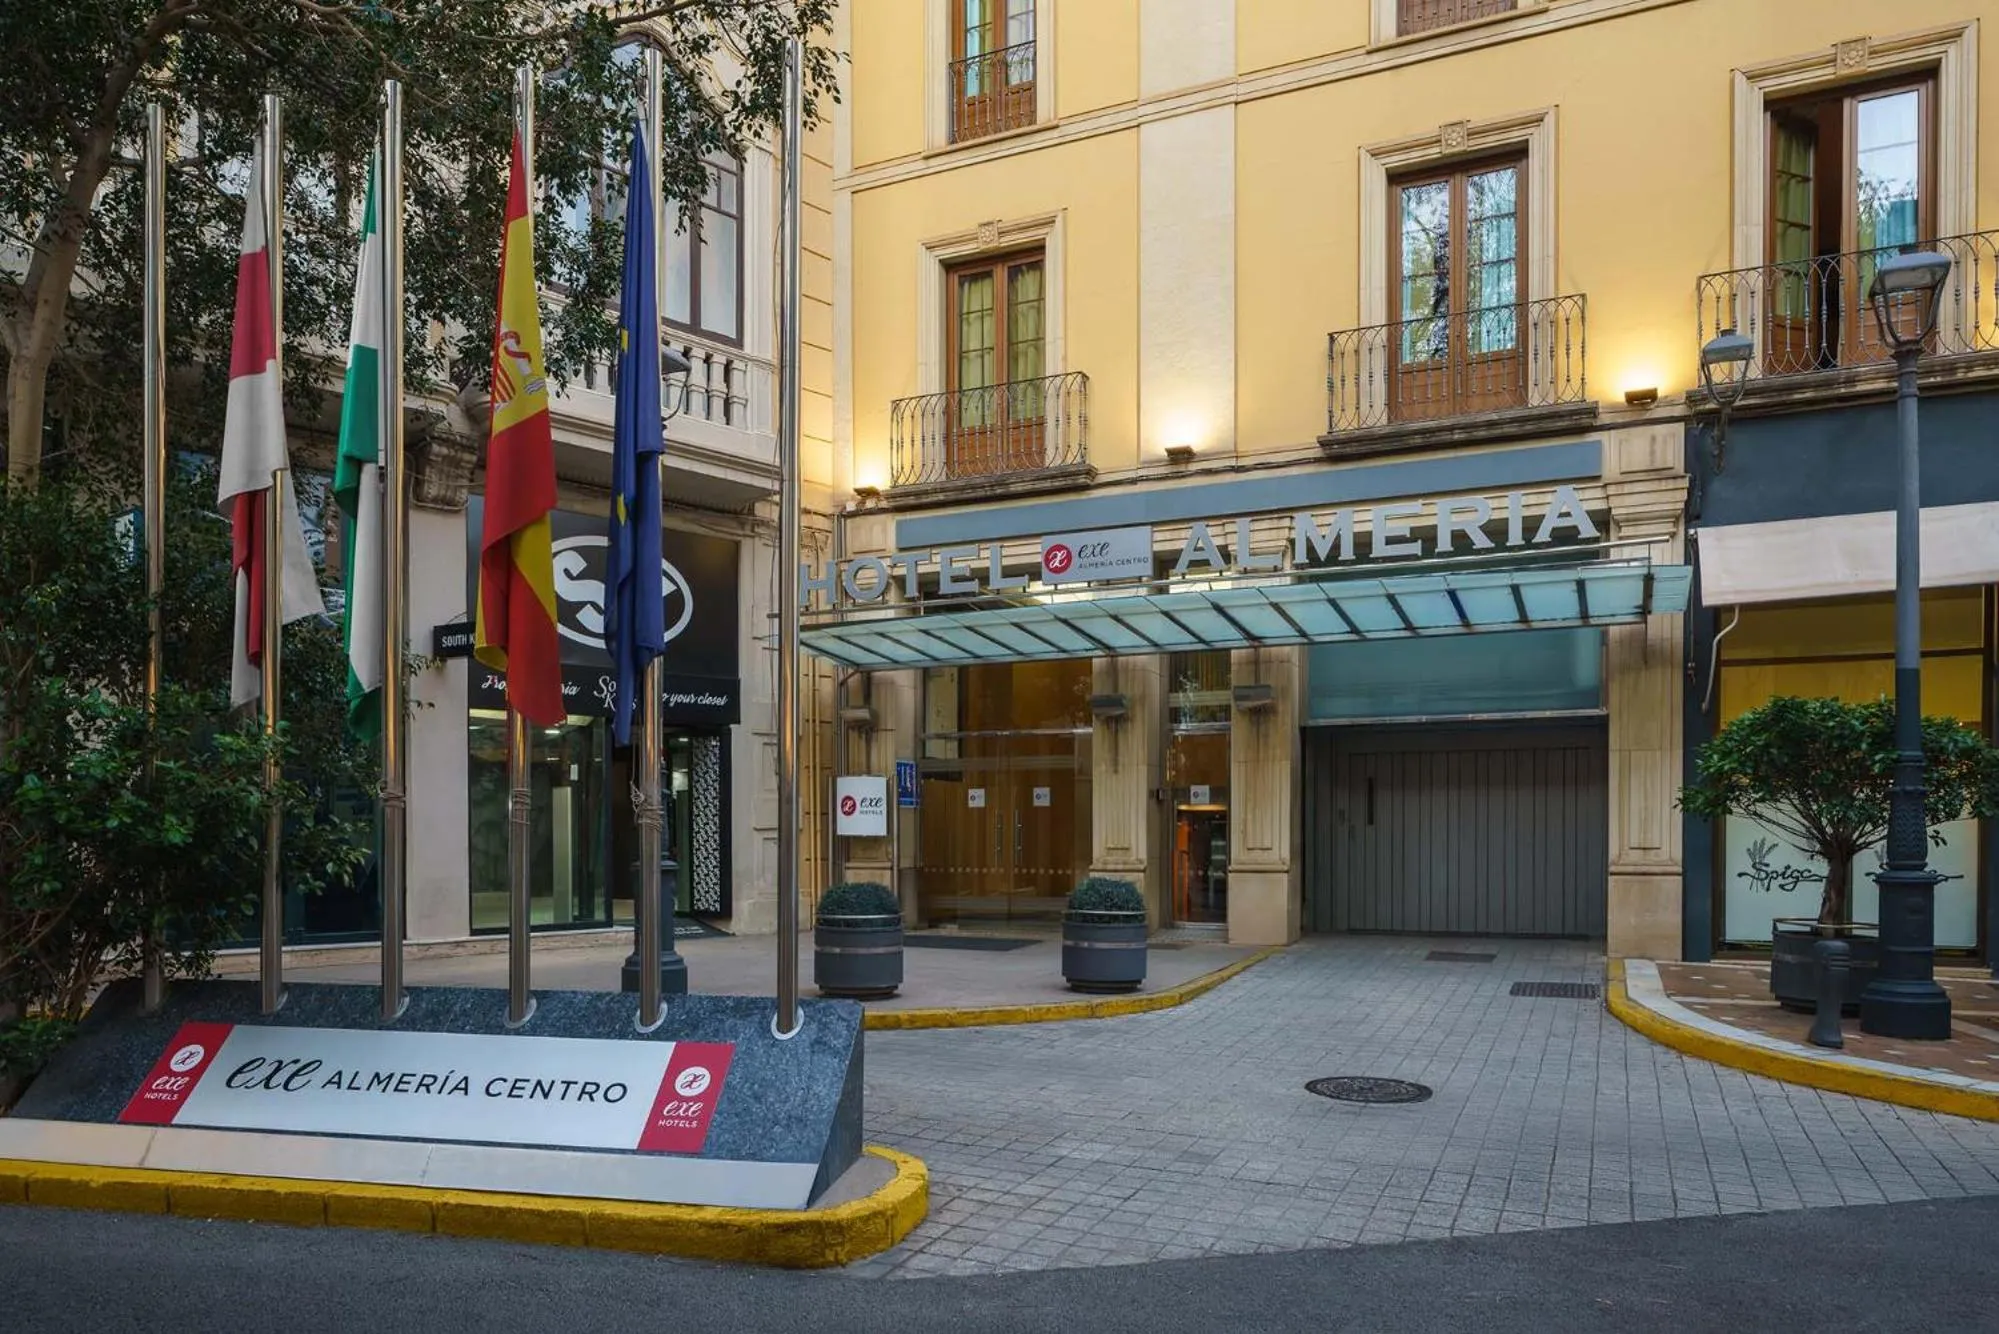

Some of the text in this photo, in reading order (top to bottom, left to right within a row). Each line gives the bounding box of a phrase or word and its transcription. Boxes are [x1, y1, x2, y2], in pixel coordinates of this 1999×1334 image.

[800, 484, 1600, 605] HOTEL ALMERIA
[1078, 542, 1110, 560] exe
[1115, 556, 1149, 567] CENTRO
[442, 635, 467, 648] SOUTH
[670, 692, 696, 707] your
[698, 692, 728, 706] closet
[860, 796, 883, 809] exe
[151, 1075, 190, 1092] exe
[225, 1056, 628, 1104] exe ALMERÍA CENTRO
[144, 1091, 179, 1101] HOTELS
[662, 1100, 702, 1118] exe
[657, 1118, 698, 1129] HOTELS
